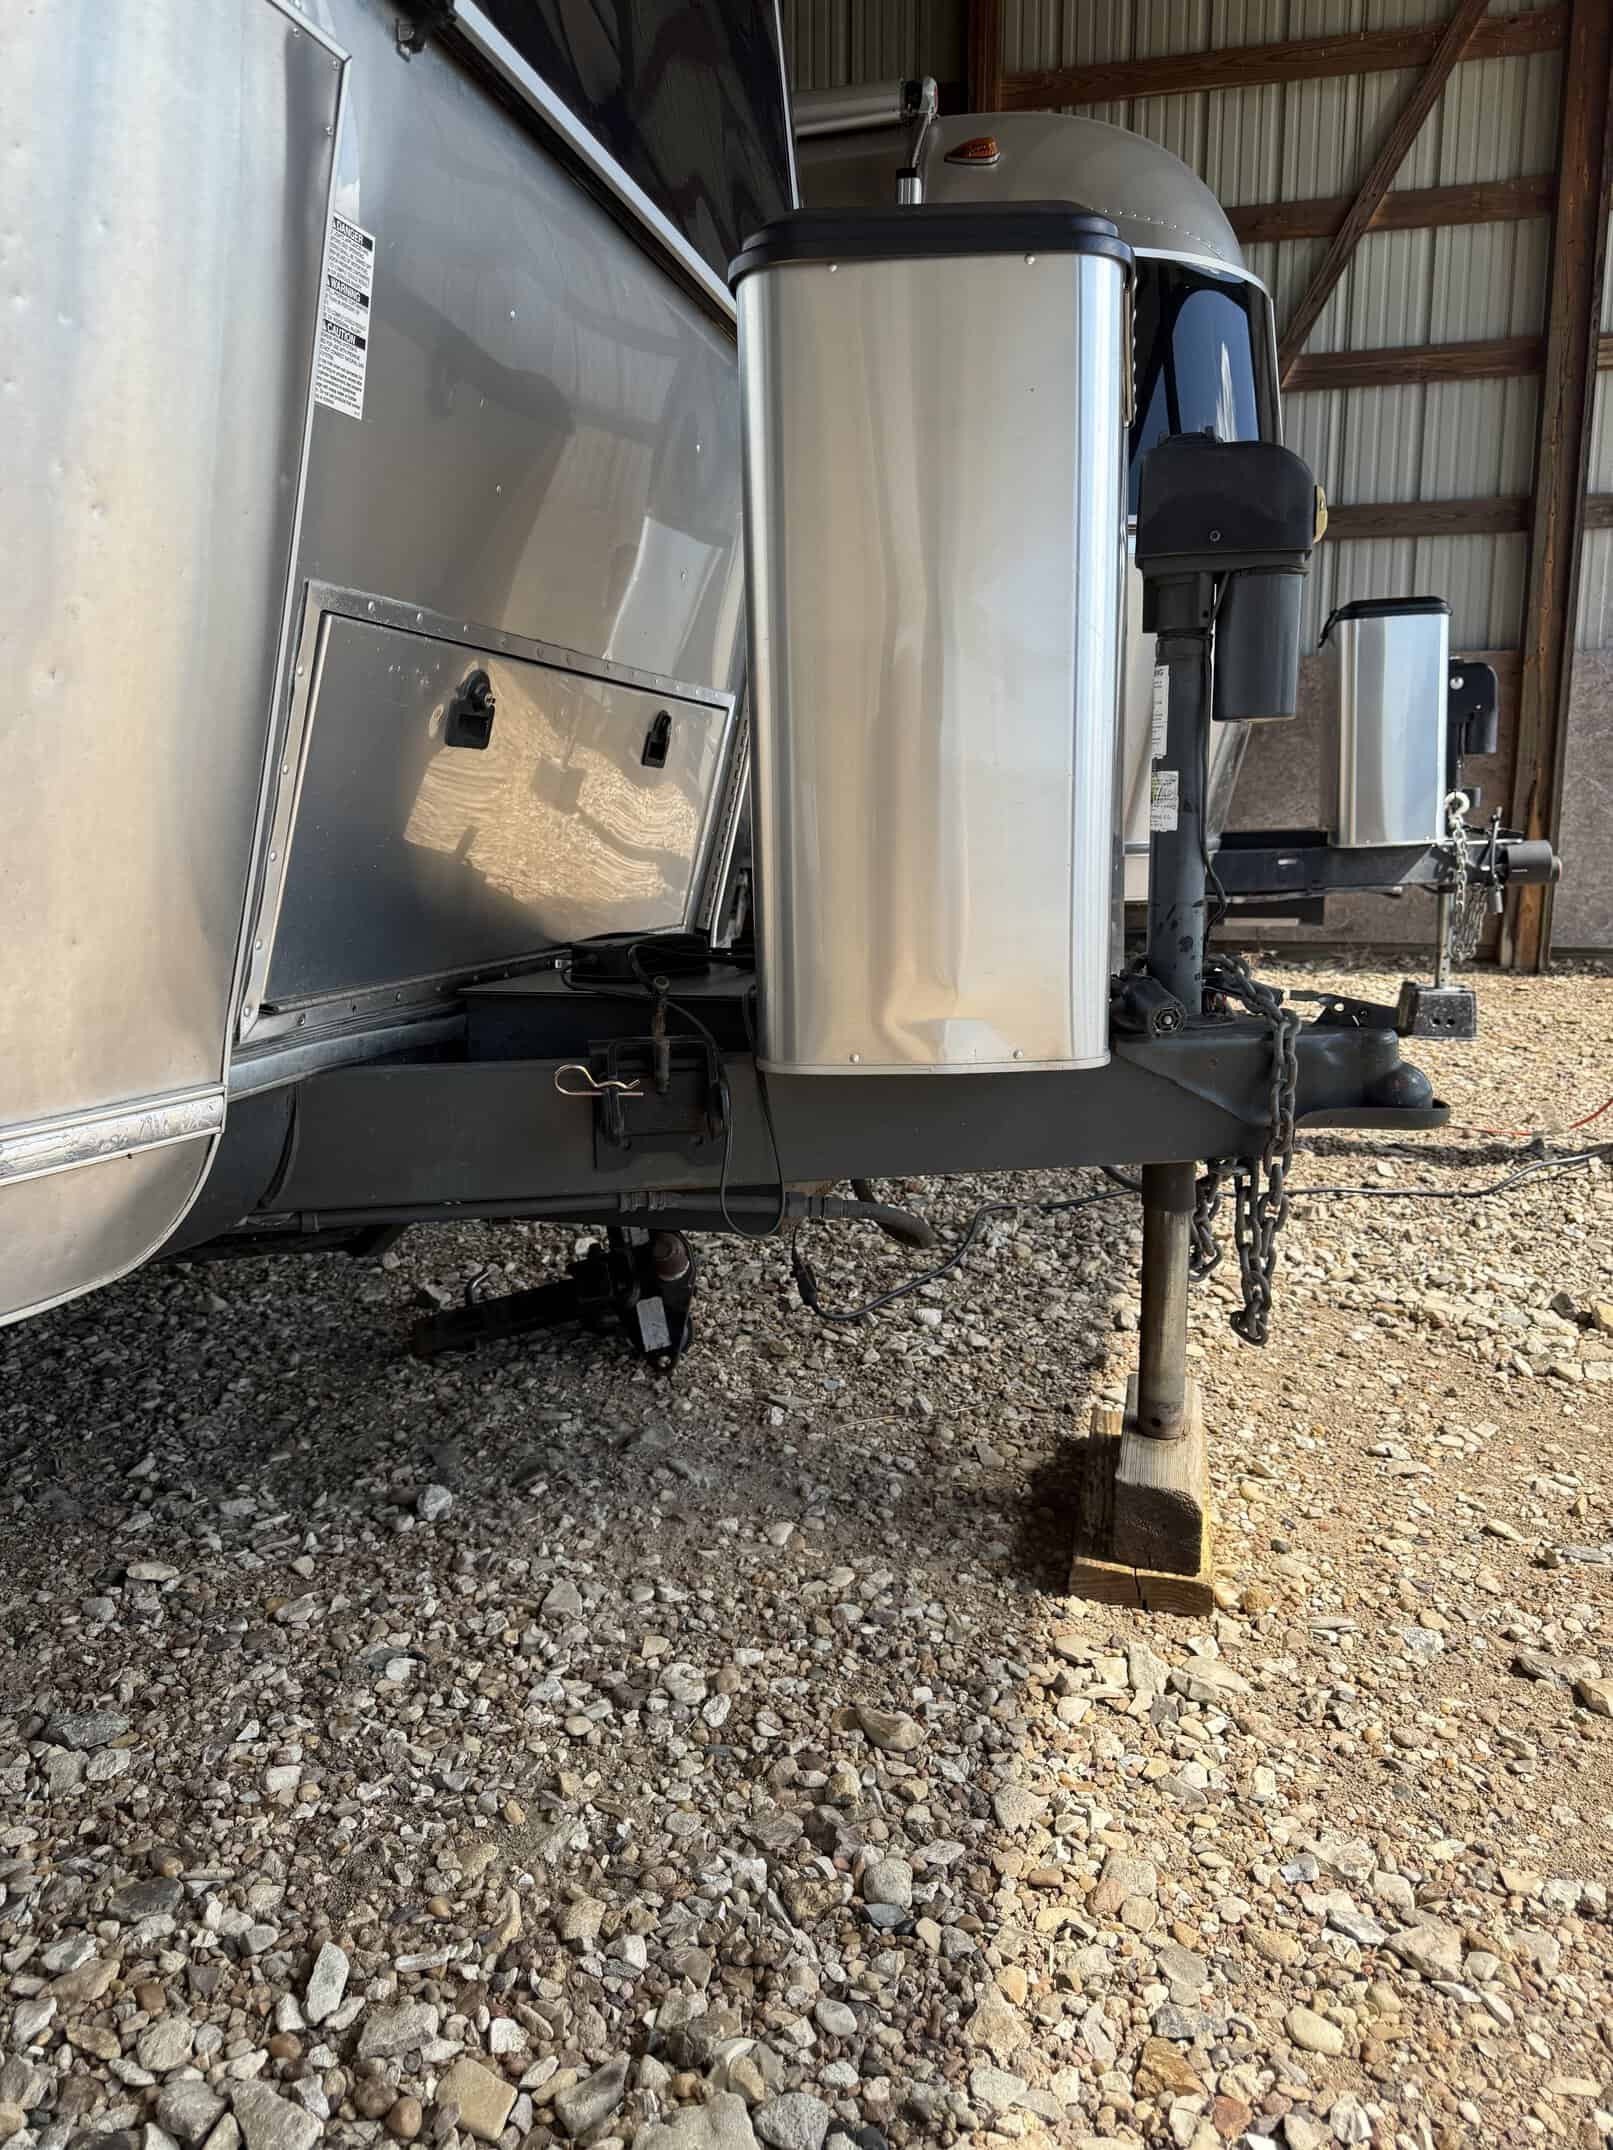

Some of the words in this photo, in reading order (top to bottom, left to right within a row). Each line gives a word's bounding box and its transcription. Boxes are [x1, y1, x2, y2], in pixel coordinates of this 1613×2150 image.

[337, 219, 363, 245] DANGER
[331, 278, 361, 303] WARNING
[327, 323, 356, 345] CAUTION
